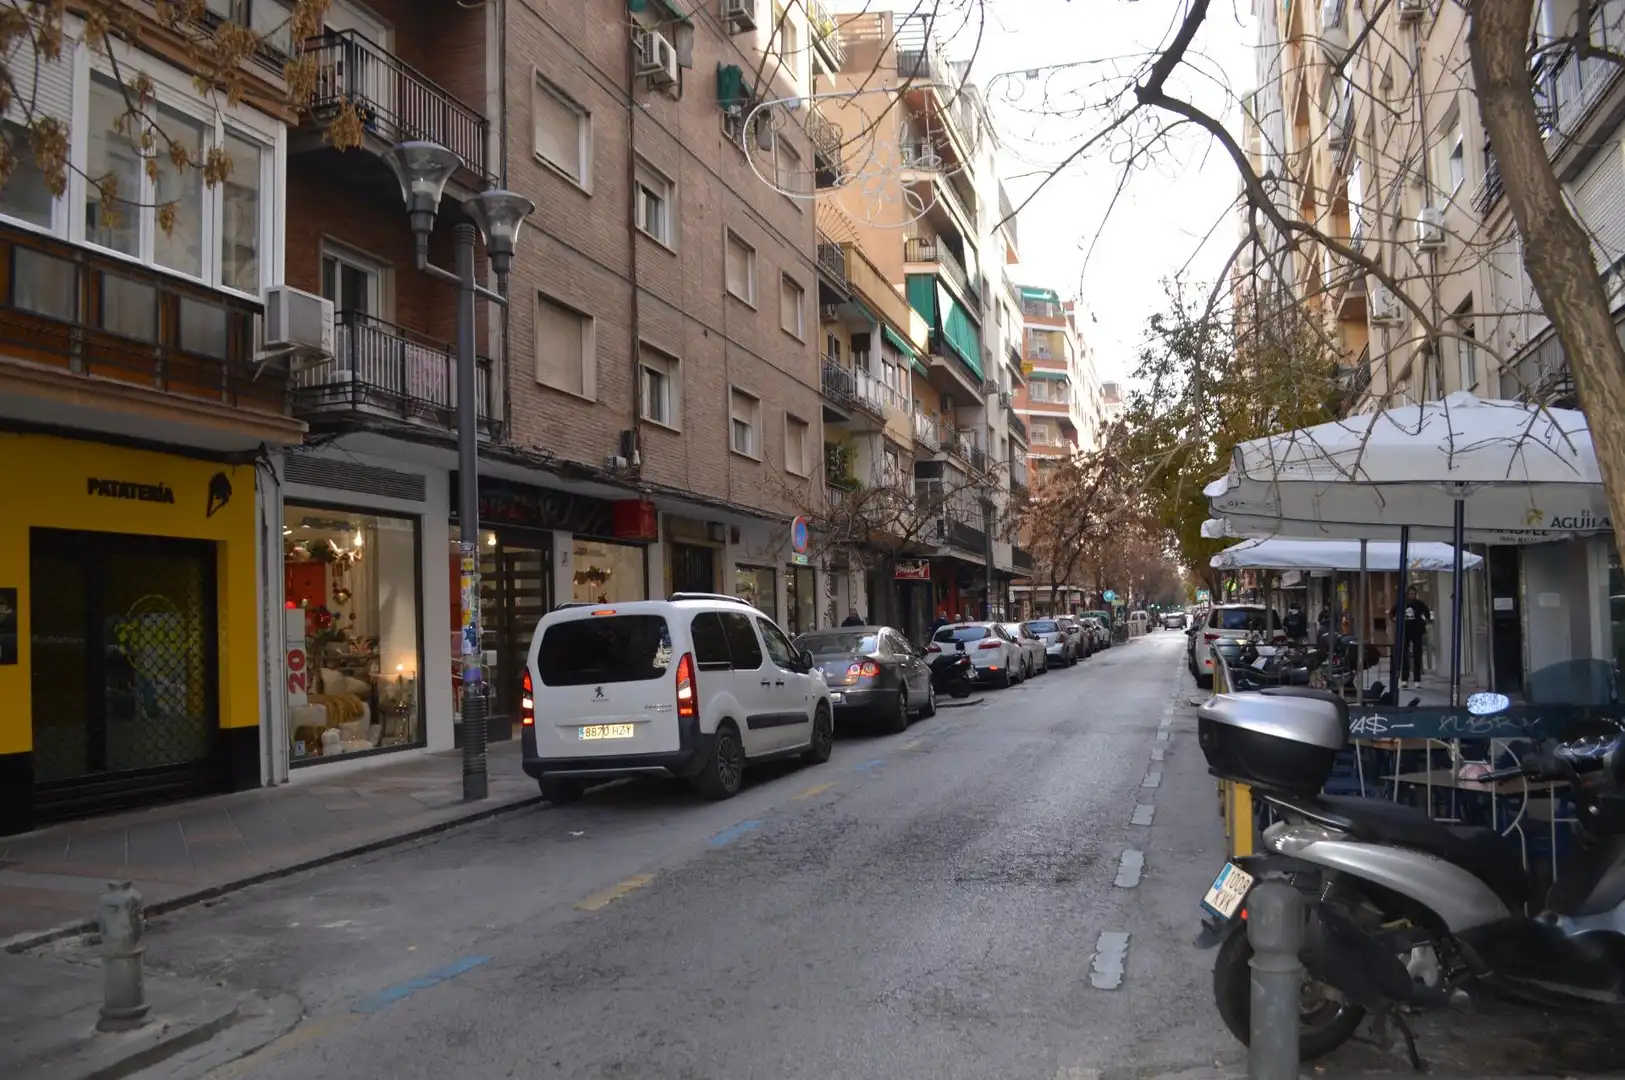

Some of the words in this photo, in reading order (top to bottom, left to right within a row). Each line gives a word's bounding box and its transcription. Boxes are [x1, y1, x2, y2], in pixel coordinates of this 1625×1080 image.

[87, 477, 174, 504] PATATERÍA
[1581, 509, 1591, 517] EL
[612, 724, 631, 736] HZY
[1225, 870, 1250, 896] 1008
